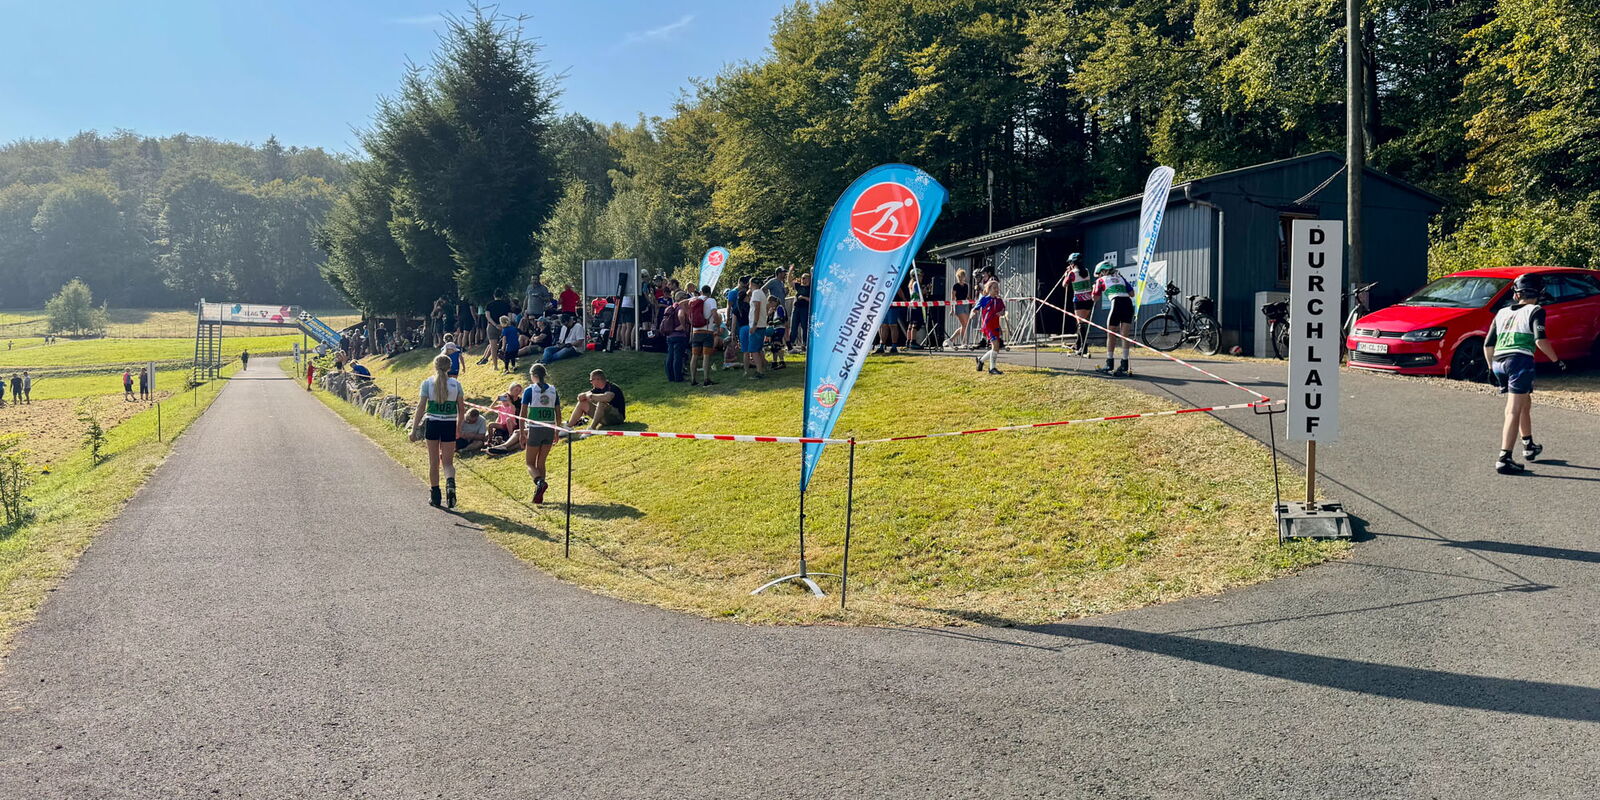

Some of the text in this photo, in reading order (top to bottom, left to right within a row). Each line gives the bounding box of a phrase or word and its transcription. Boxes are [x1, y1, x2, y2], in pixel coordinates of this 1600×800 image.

[832, 274, 879, 354] THÜRINGER
[839, 291, 886, 380] SKIVERBAND
[1305, 228, 1325, 434] DURCHLAUF
[539, 410, 552, 419] 109
